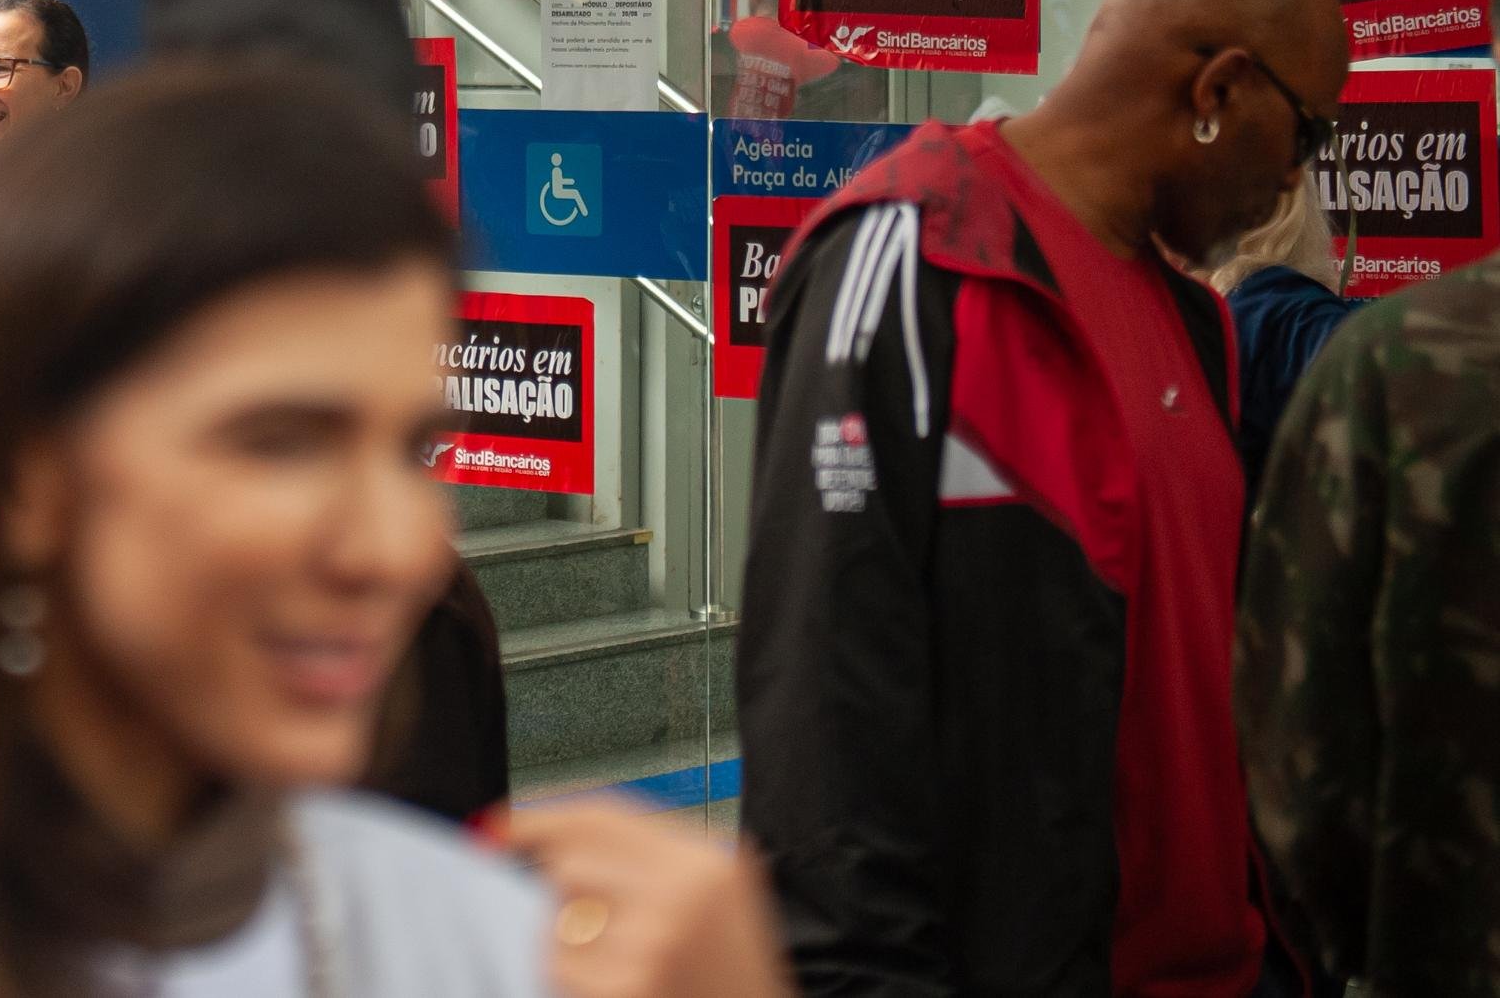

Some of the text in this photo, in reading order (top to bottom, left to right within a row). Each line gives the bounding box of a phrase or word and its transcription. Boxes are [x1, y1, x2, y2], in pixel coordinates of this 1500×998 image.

[1352, 6, 1482, 39] SindBancários
[1465, 20, 1481, 29] CUT
[876, 30, 987, 51] SindBancários
[733, 135, 813, 161] Agência
[1416, 133, 1467, 161] em
[733, 164, 785, 191] Praça
[792, 166, 817, 188] da
[1319, 163, 1470, 219] LISAÇÃO
[433, 334, 572, 375] ncários em
[444, 376, 573, 423] ALISAÇÃO
[454, 448, 551, 471] SindBancários
